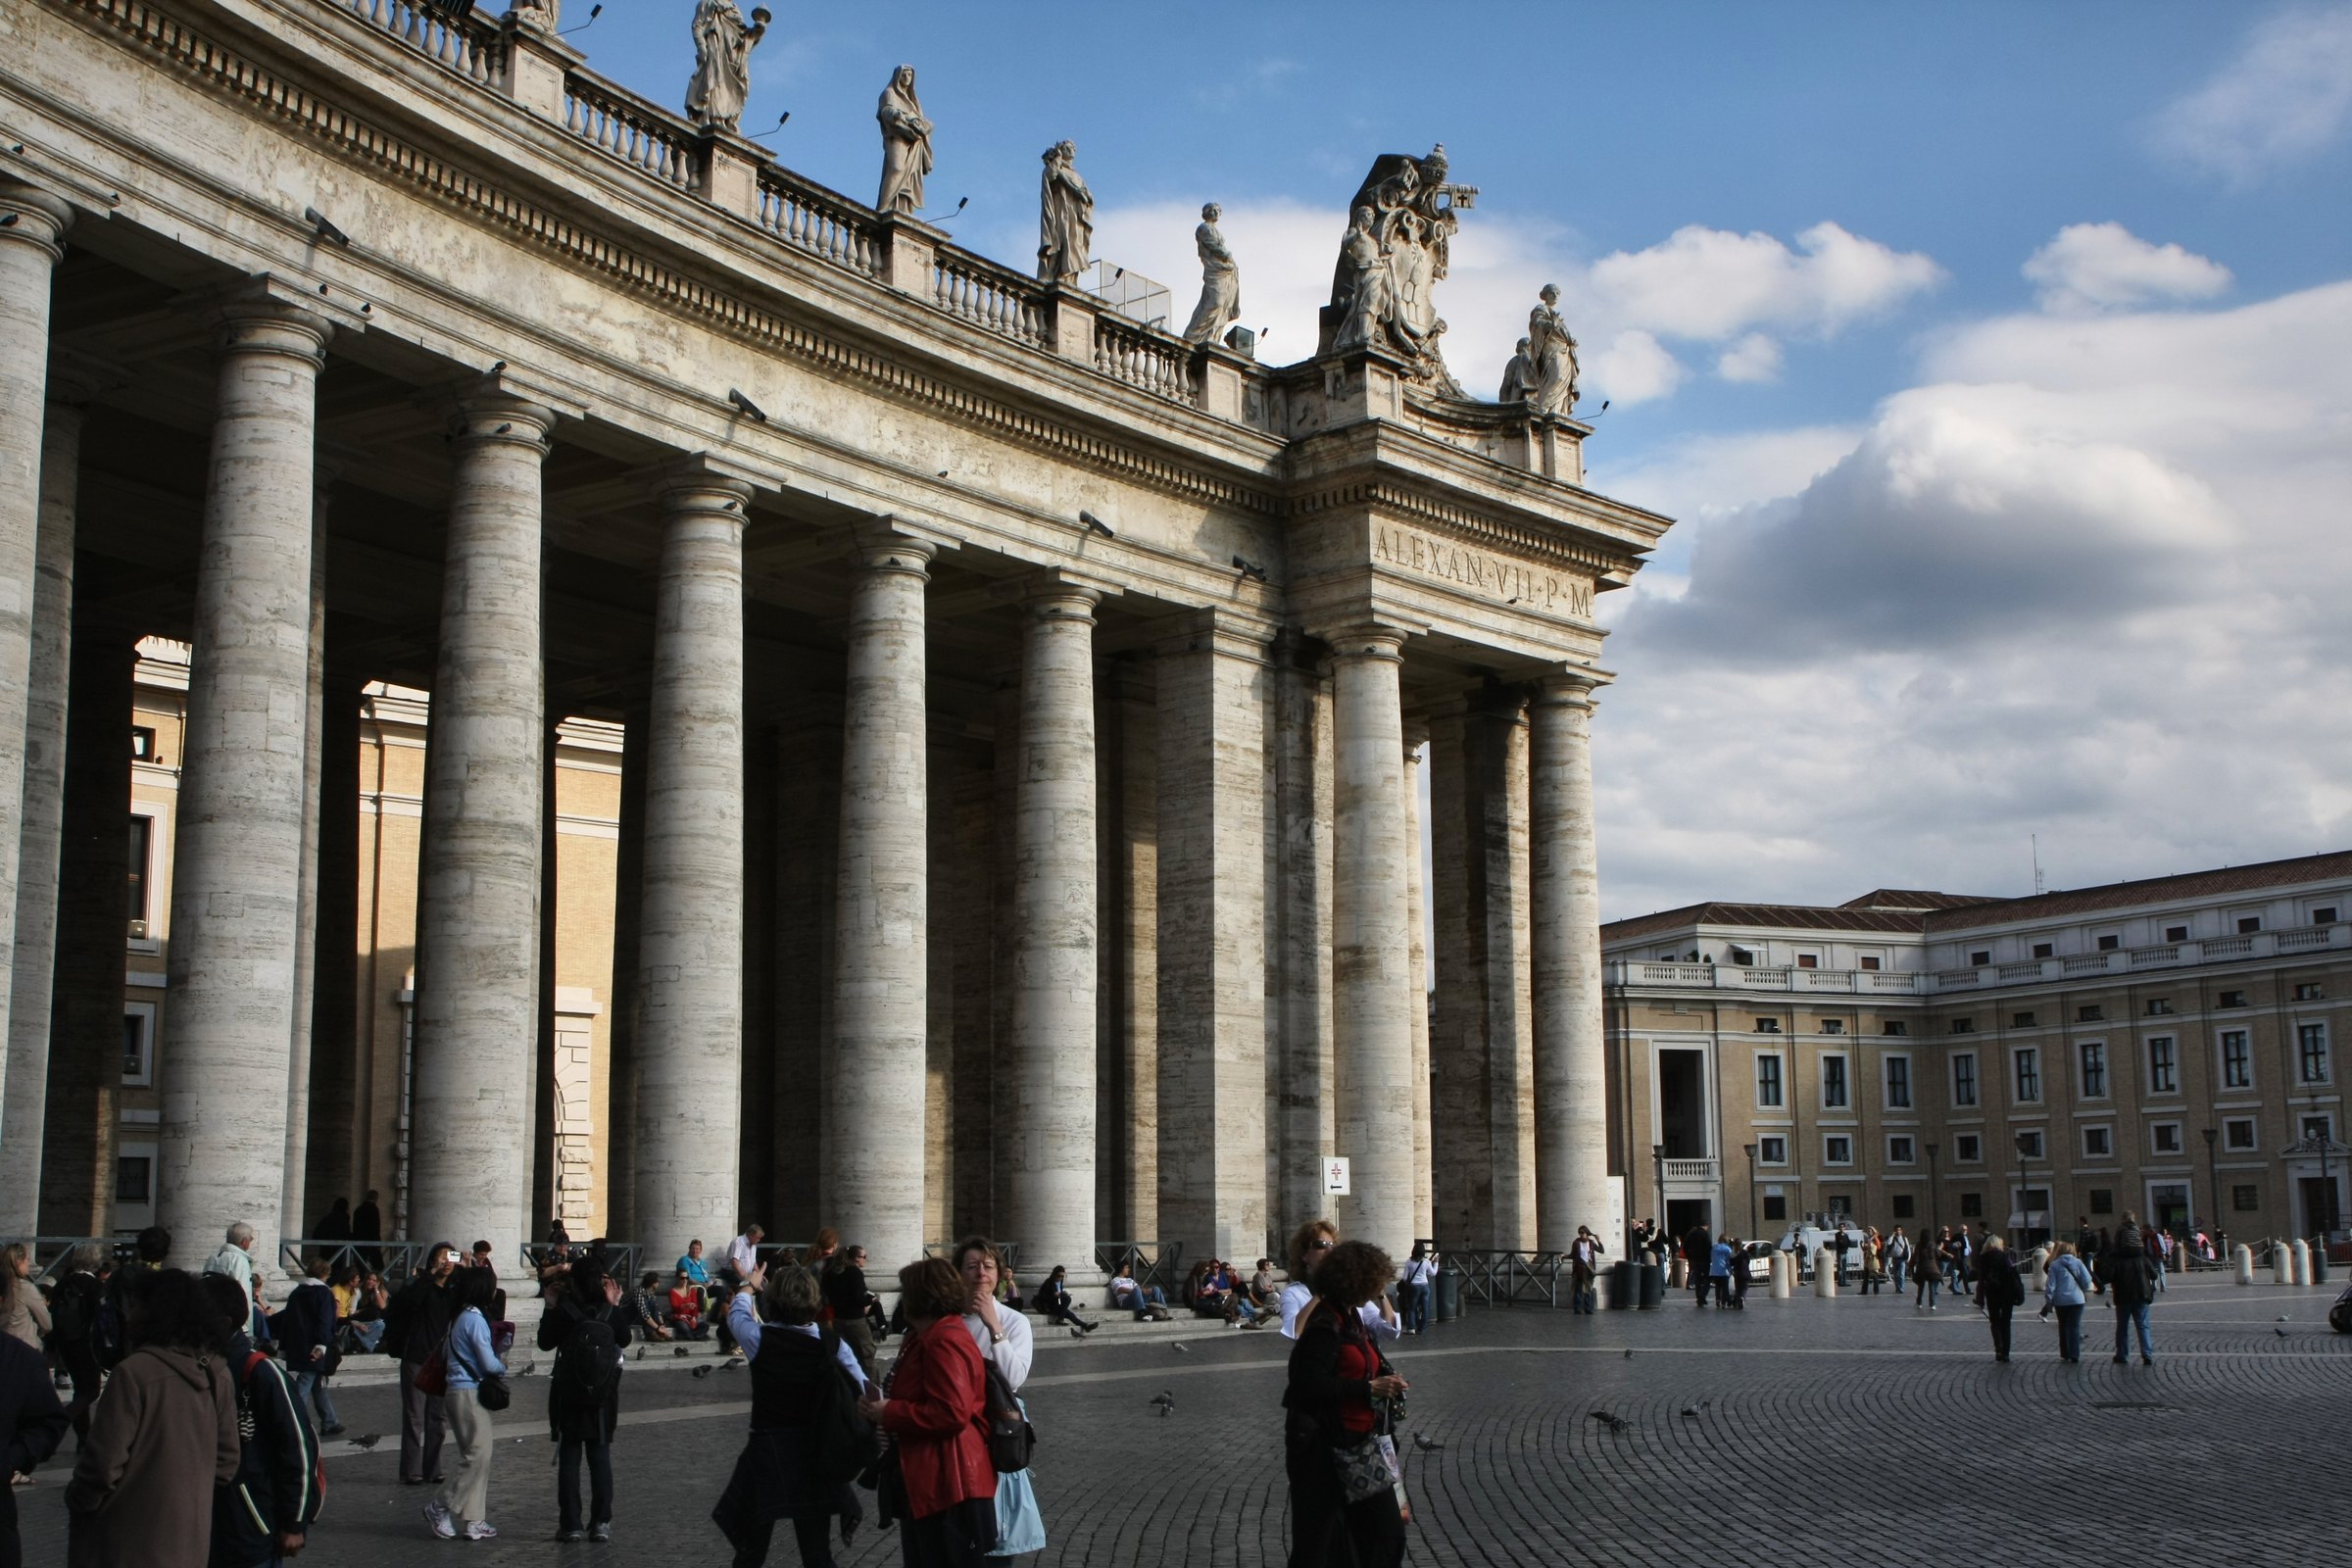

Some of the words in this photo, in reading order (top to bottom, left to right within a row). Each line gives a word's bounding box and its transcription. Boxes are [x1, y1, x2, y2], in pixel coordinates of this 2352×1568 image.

[1374, 525, 1483, 587] ALEXAN
[1493, 561, 1534, 603] VII
[1545, 576, 1558, 608] P
